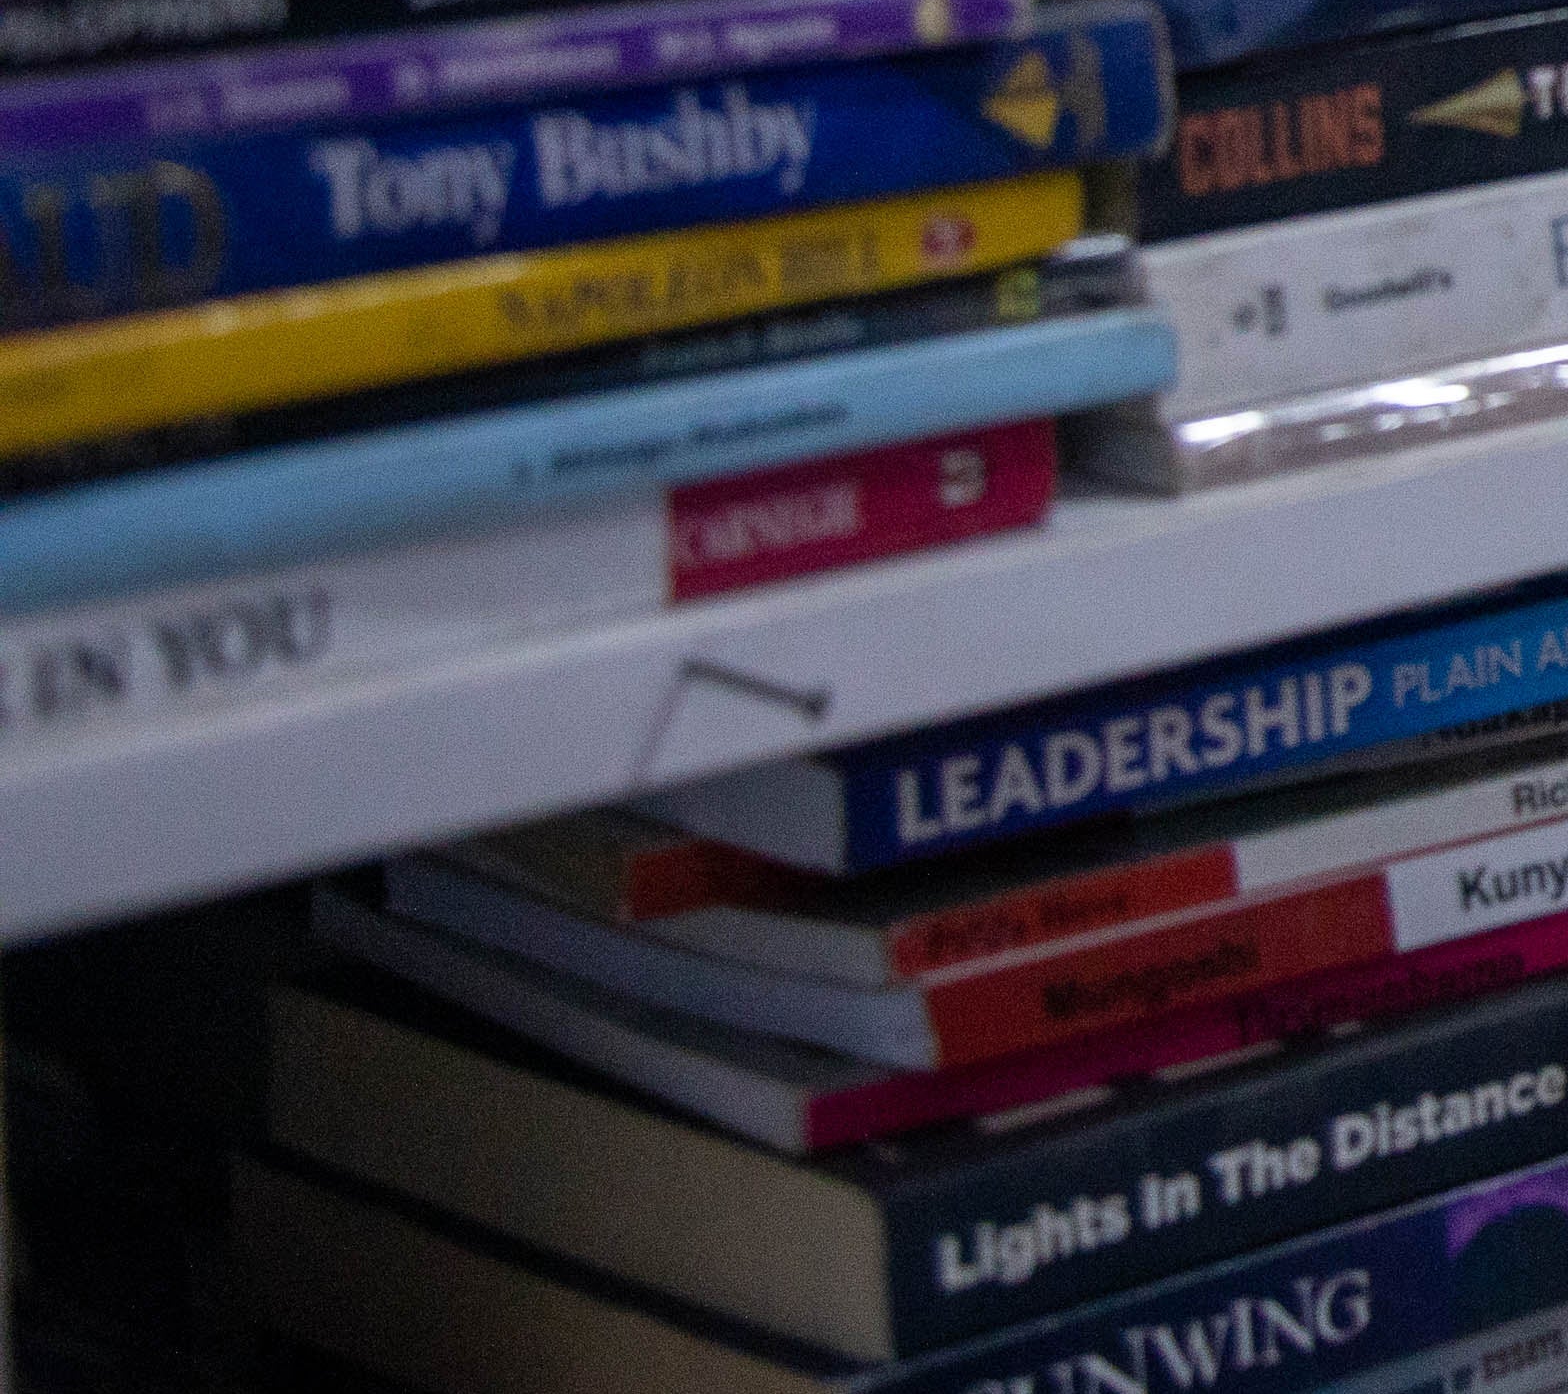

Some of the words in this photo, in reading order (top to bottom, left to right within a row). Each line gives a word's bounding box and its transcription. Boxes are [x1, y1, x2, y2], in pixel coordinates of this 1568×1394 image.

[314, 134, 511, 244] Tony
[532, 89, 814, 209] Bushby
[898, 663, 1373, 845] LEADERSHIP
[936, 1192, 1128, 1294] Lights
[1140, 1172, 1200, 1229] In
[1208, 1139, 1320, 1205] The
[1330, 1064, 1568, 1169] Distance
